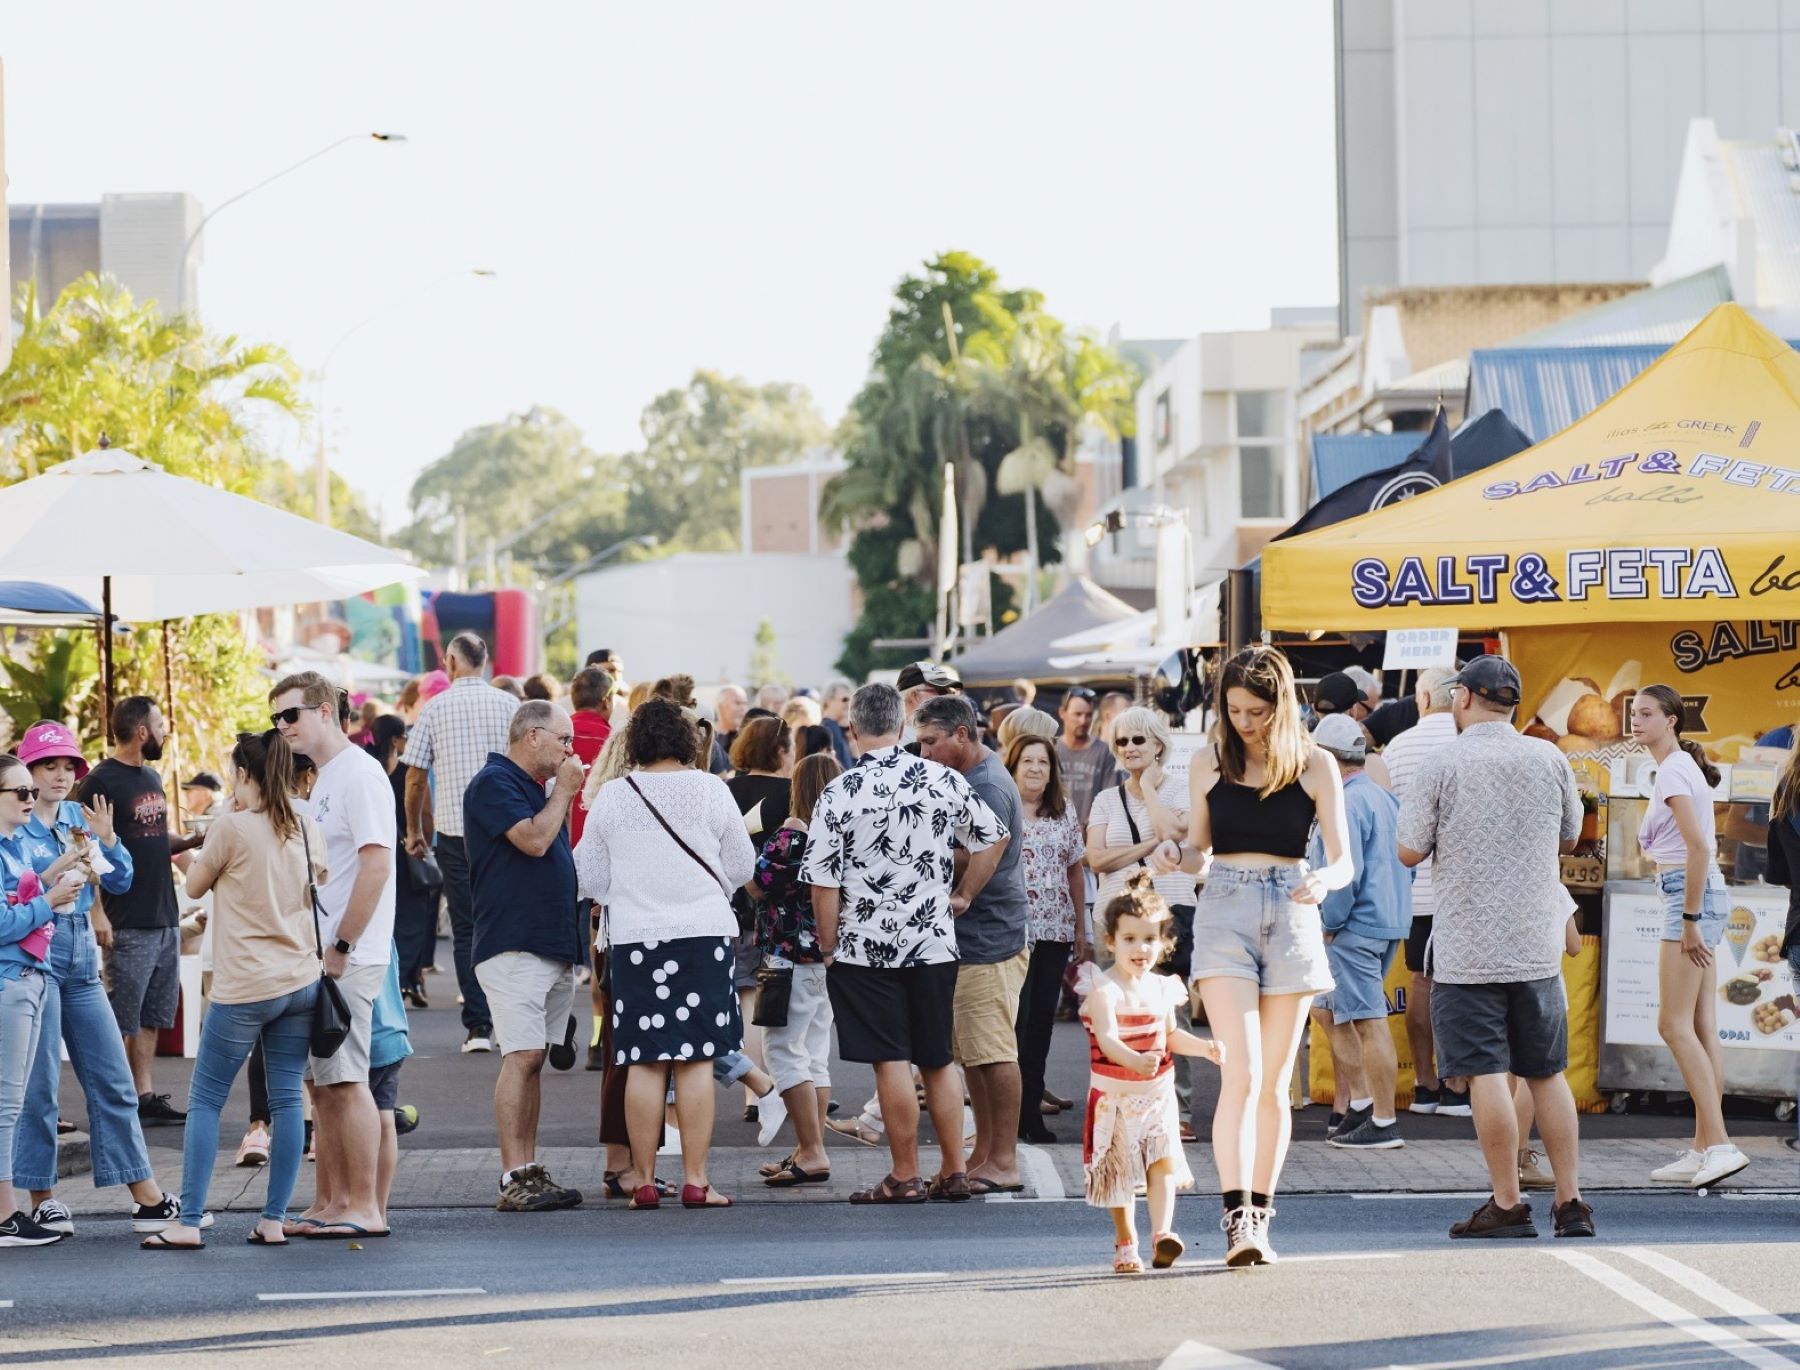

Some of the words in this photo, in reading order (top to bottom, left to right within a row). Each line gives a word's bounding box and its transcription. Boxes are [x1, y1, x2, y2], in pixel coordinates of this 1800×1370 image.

[1677, 419, 1738, 435] GREEK
[1566, 547, 1740, 600] FETA
[1396, 630, 1450, 643] ORDER
[1400, 645, 1443, 658] HERE
